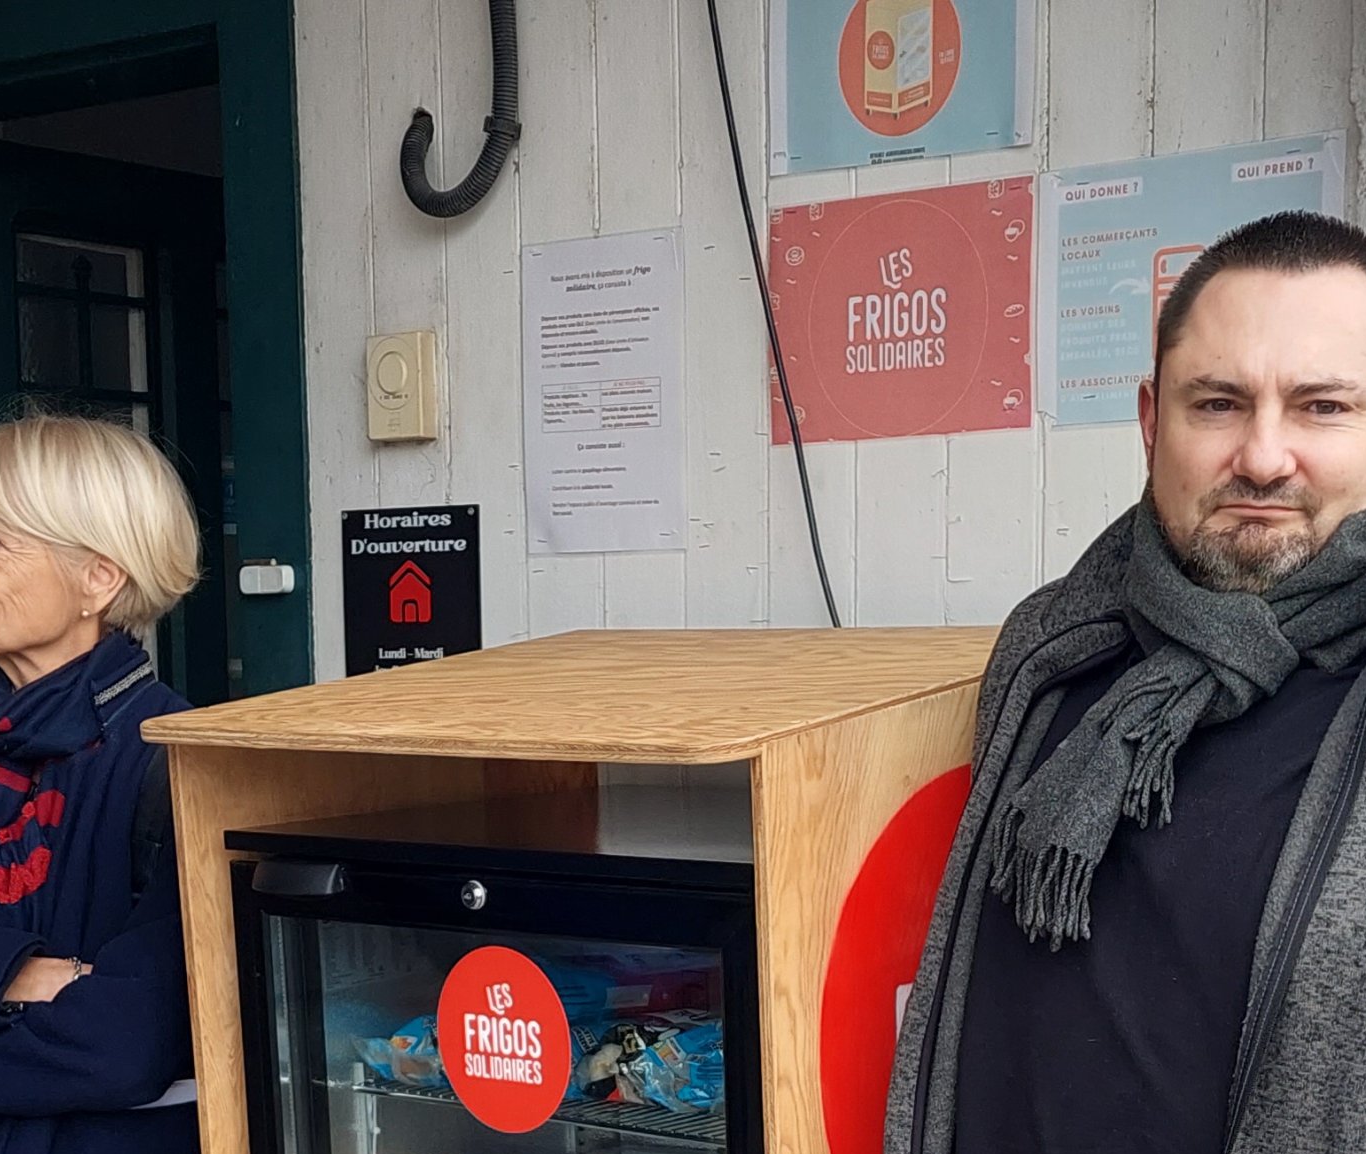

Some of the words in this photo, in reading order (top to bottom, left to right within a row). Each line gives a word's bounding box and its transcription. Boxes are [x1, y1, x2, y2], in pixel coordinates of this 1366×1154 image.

[1237, 165, 1260, 179] QUI
[1263, 160, 1304, 176] PREND
[1307, 157, 1315, 171] ?
[1065, 188, 1086, 202] QUI
[1089, 183, 1129, 199] DONNE
[1132, 182, 1139, 193] ?
[1061, 237, 1078, 248] LES
[1081, 228, 1158, 245] COMMERÇANTS
[1061, 249, 1101, 261] LOCAUX
[879, 248, 913, 289] LES
[848, 287, 947, 342] FRIGOS
[1060, 308, 1077, 318] LES
[1080, 304, 1121, 316] VOISINS
[846, 337, 945, 374] SOLIDAIRES
[1060, 380, 1076, 389] LES
[364, 511, 452, 529] Horaires
[350, 538, 467, 555] D'ouverture
[378, 647, 406, 659] Lundi
[414, 647, 444, 659] Mardi
[485, 983, 514, 1015] LES
[464, 1013, 542, 1059] FRIGOS
[464, 1052, 543, 1085] SOLIDAIRES
